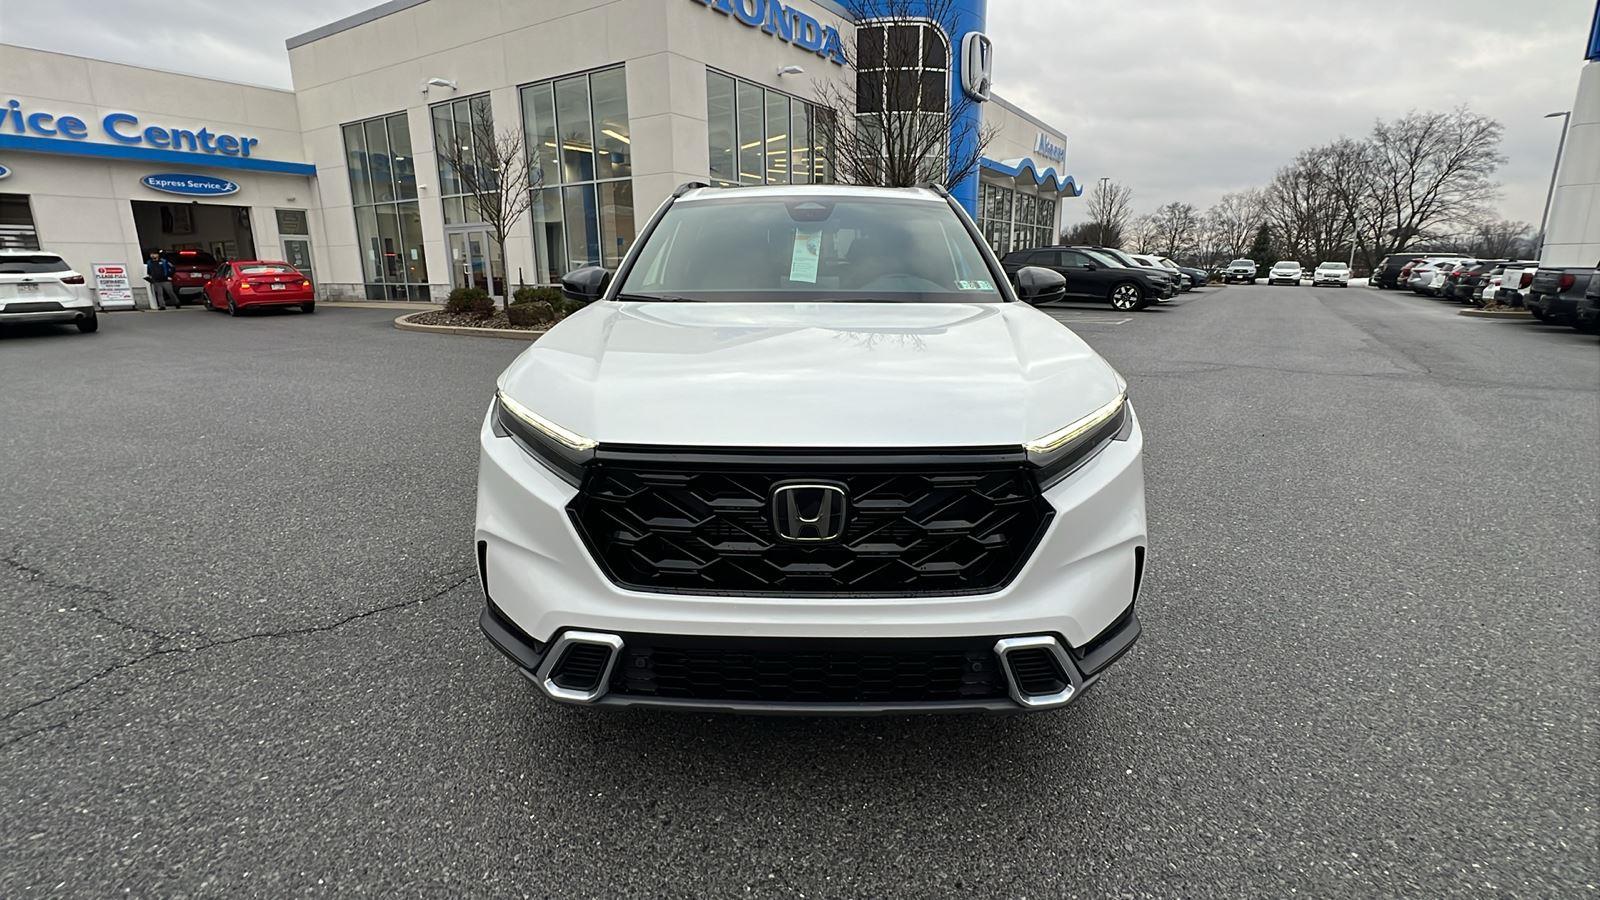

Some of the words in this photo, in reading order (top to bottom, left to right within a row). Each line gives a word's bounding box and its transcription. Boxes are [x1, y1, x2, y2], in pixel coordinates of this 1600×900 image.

[102, 112, 258, 157] Center
[148, 177, 186, 188] Express
[187, 180, 221, 190] Service
